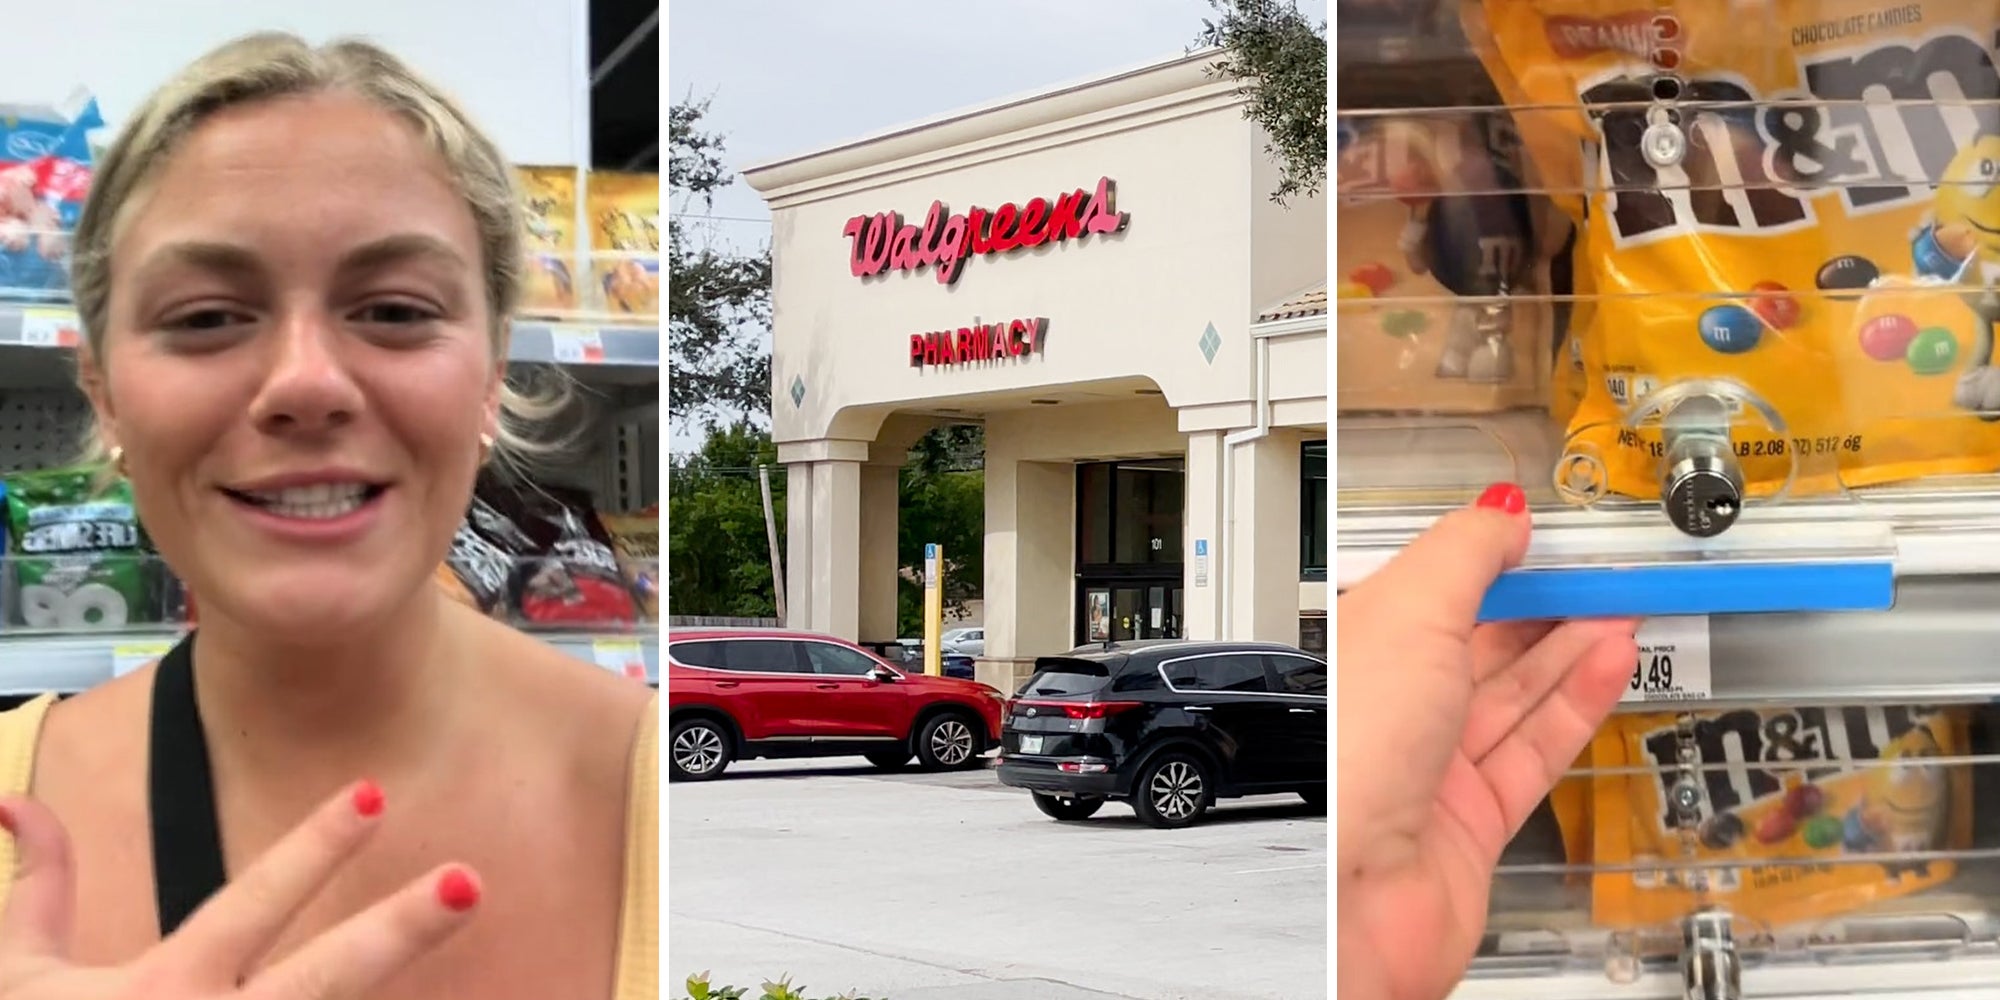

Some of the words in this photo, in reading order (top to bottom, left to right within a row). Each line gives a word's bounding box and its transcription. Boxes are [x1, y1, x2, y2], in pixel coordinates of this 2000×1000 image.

[1791, 14, 1864, 46] CHOCOLATE
[1868, 4, 1922, 35] CANDIES
[843, 176, 1130, 284] Walgreens
[910, 317, 1050, 367] PHARMACY
[1753, 439, 1785, 456] 2.08
[1151, 538, 1162, 550] 101
[1654, 645, 1676, 653] PRICE
